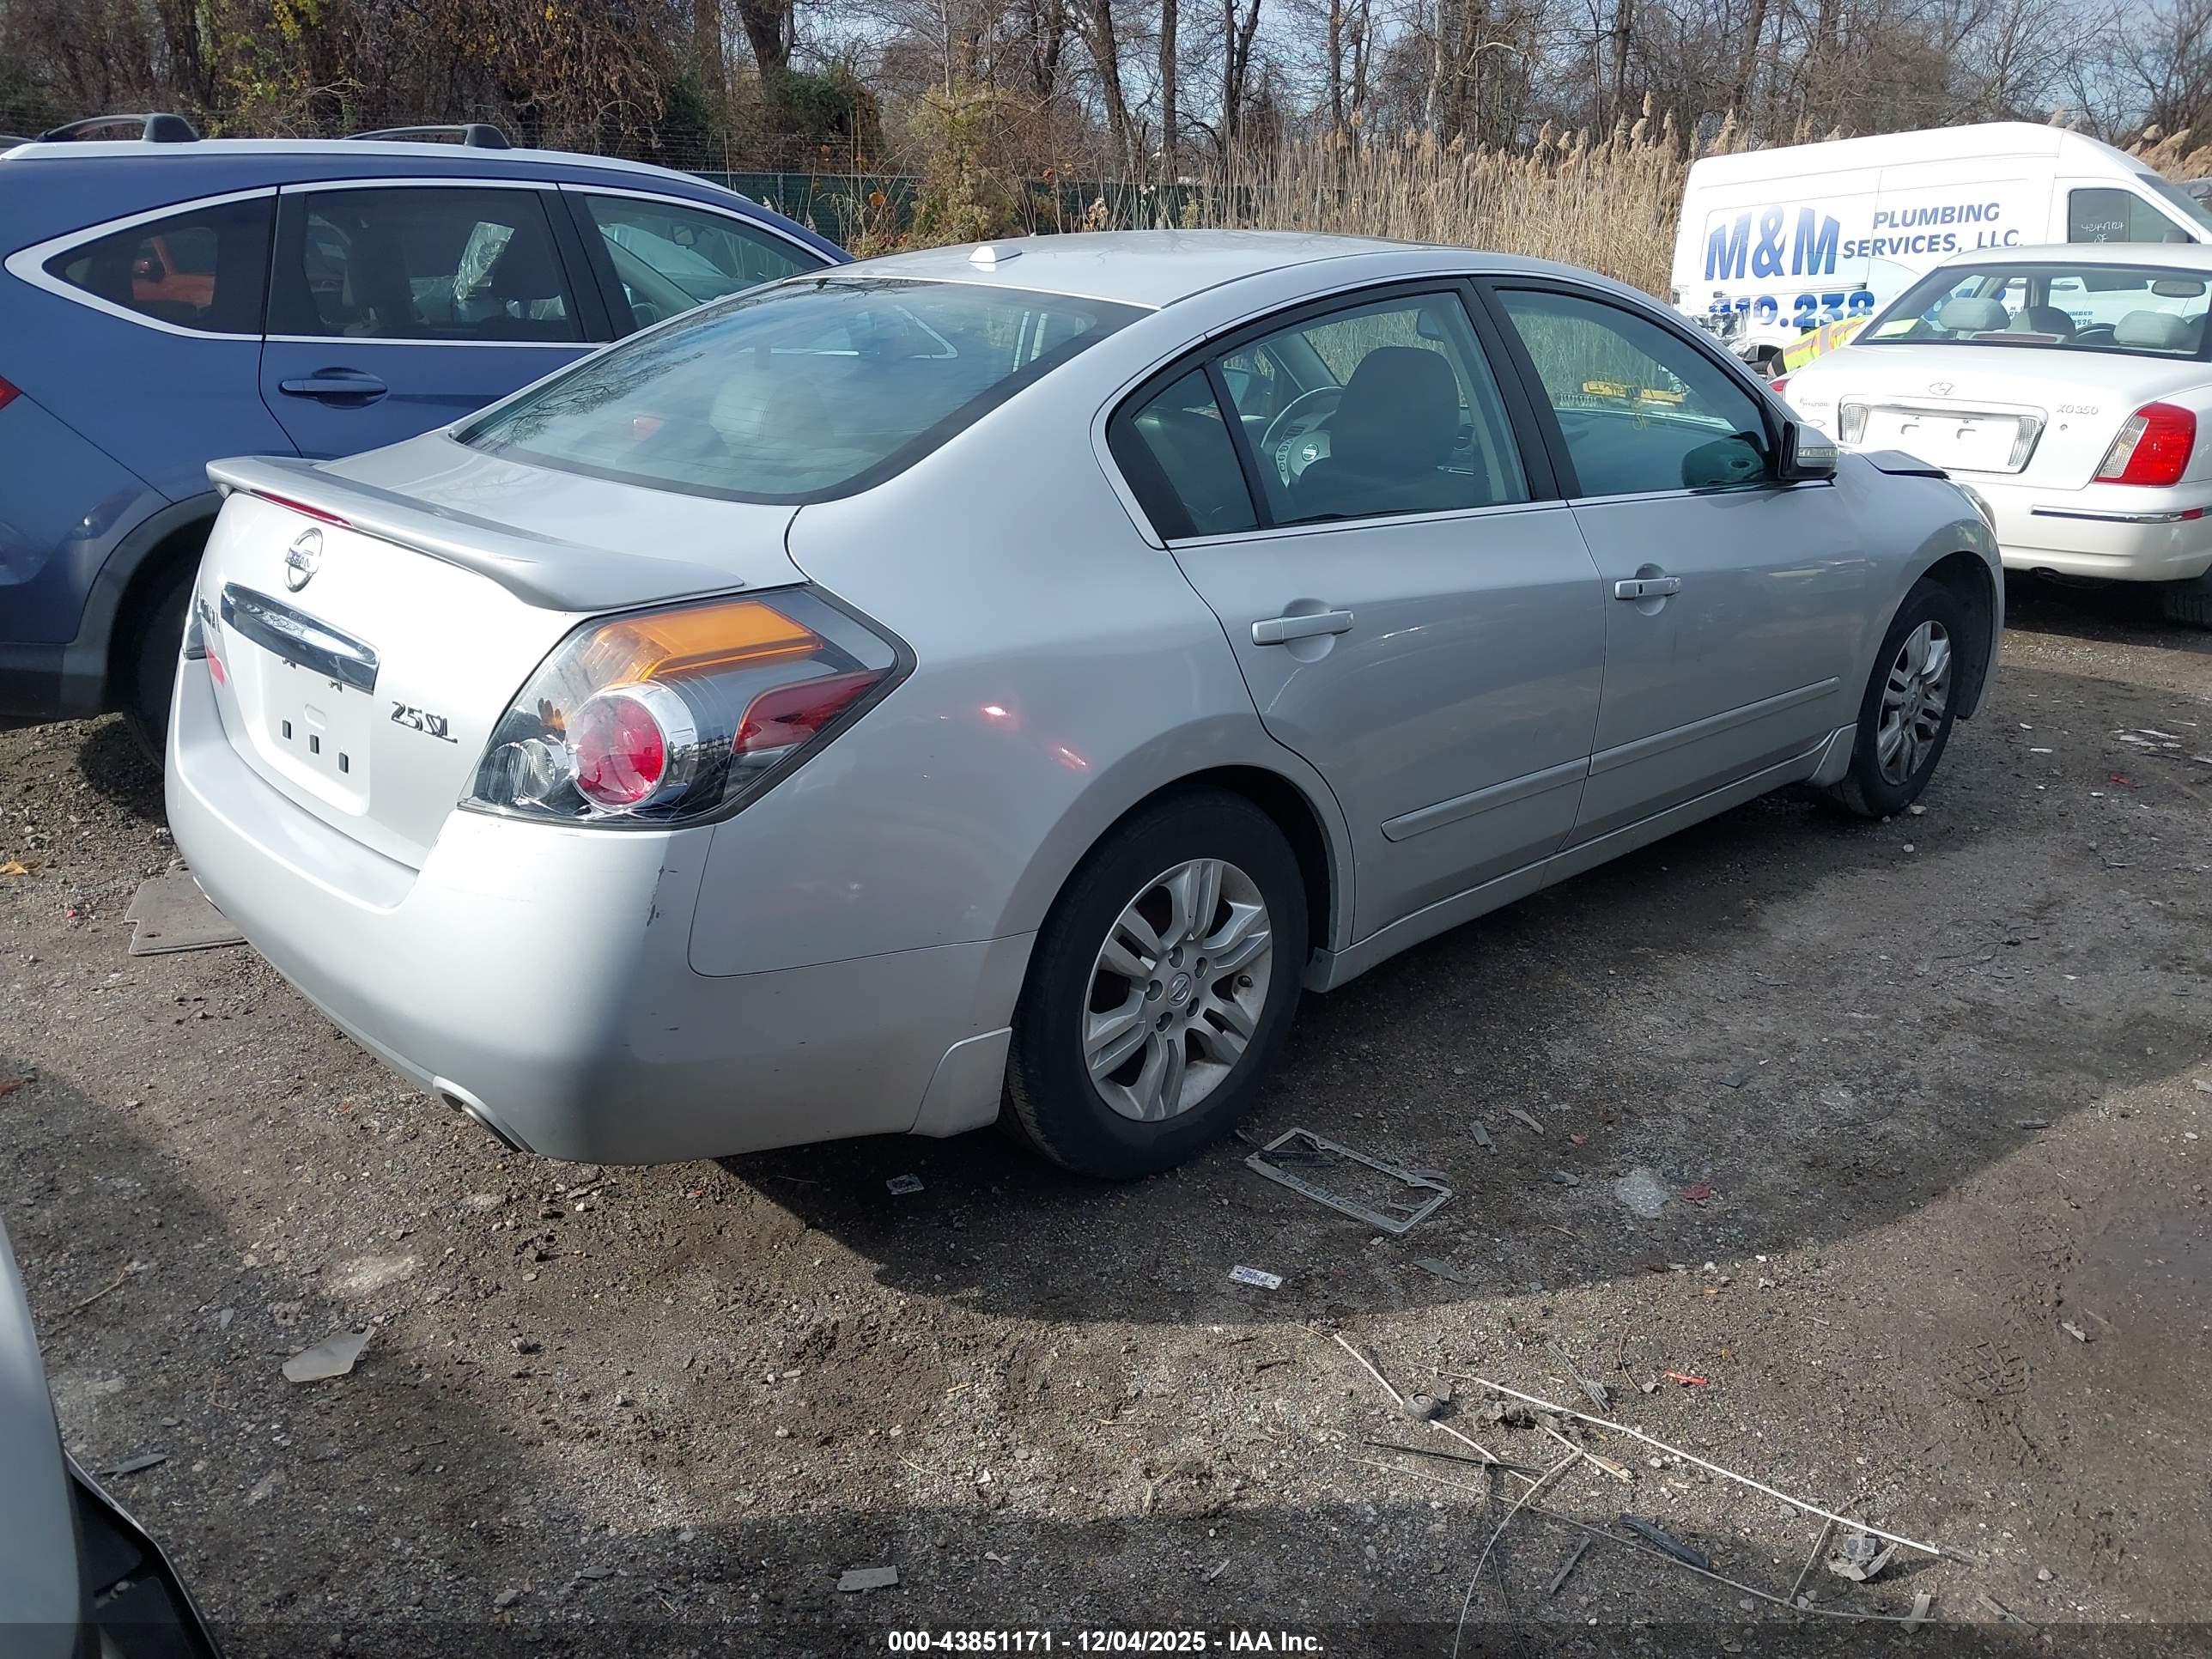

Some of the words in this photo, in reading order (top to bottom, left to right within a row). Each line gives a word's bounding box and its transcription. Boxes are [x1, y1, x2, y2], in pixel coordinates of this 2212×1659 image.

[1873, 203, 2000, 229] PLUMBING
[1705, 204, 1840, 281] M&M
[1843, 233, 1962, 259] SERVICES,
